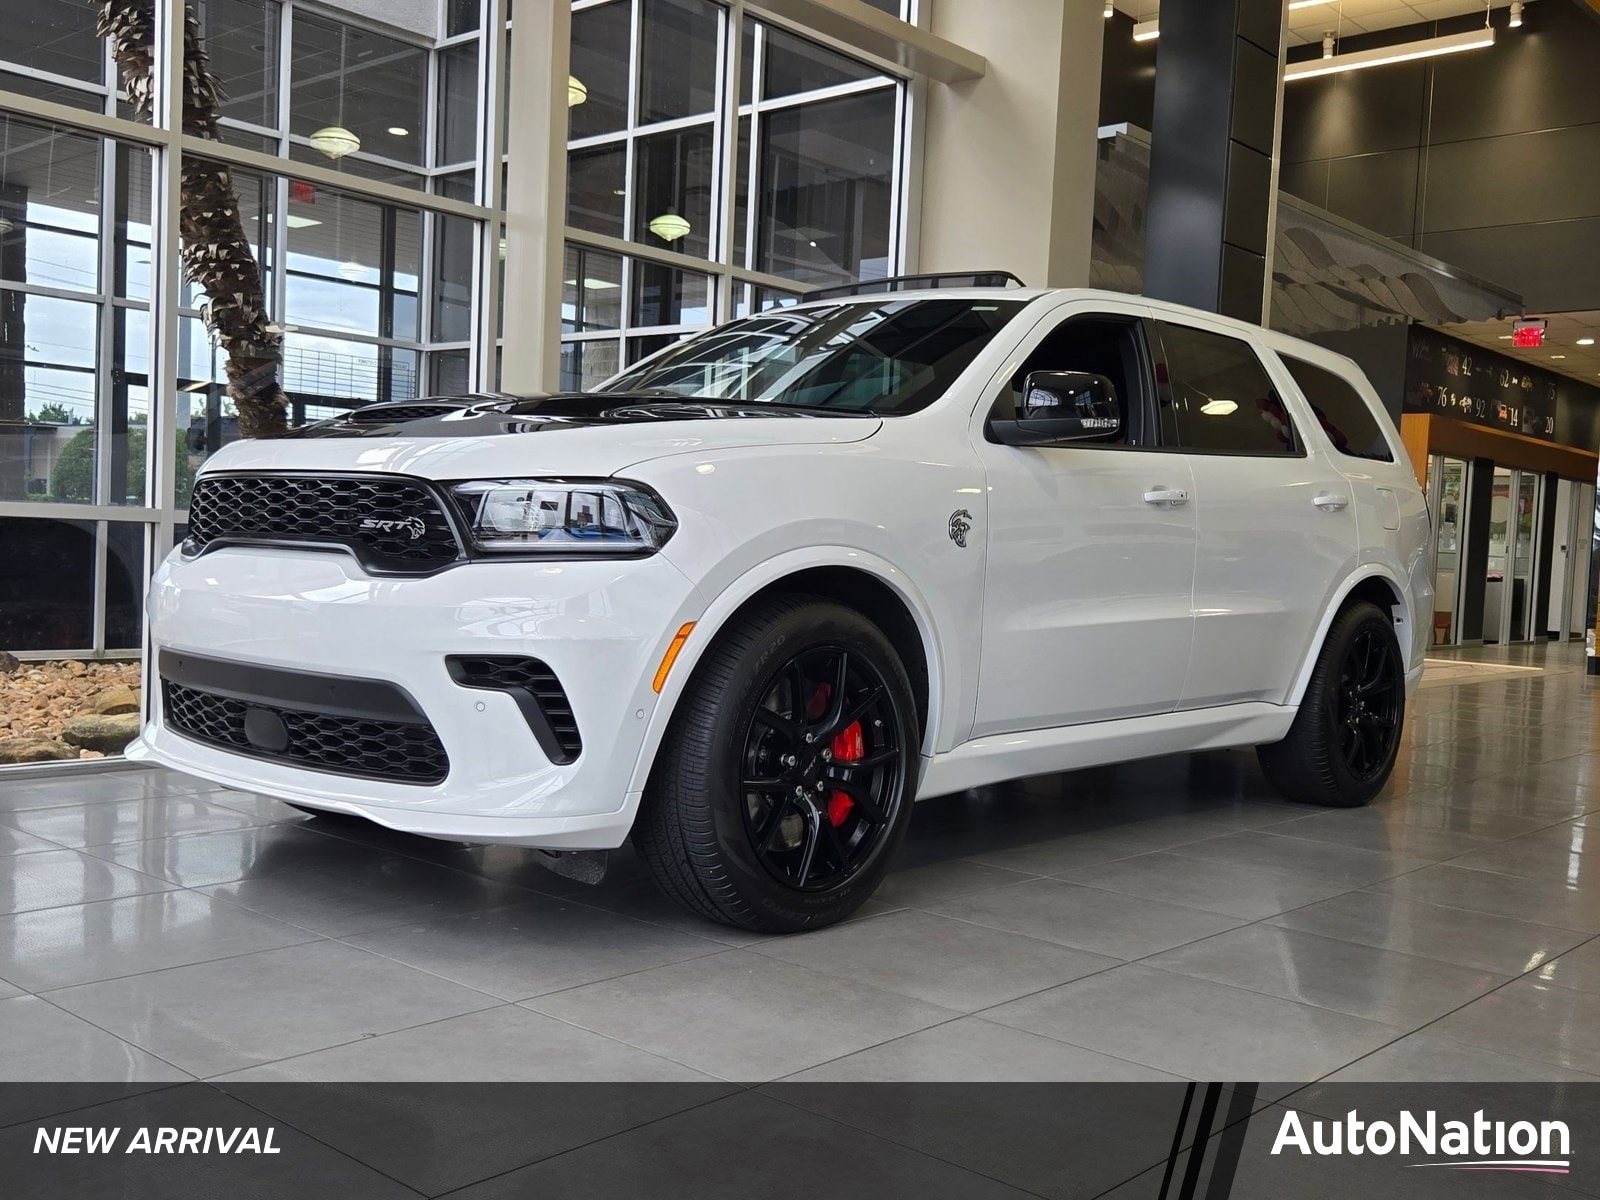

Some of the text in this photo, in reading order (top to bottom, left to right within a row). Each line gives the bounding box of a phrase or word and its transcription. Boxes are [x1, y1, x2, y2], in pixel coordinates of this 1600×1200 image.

[1462, 355, 1472, 376] 42
[1500, 368, 1509, 388] 62
[1437, 386, 1448, 407] 76
[1475, 398, 1486, 418] 92
[360, 519, 411, 532] SRT
